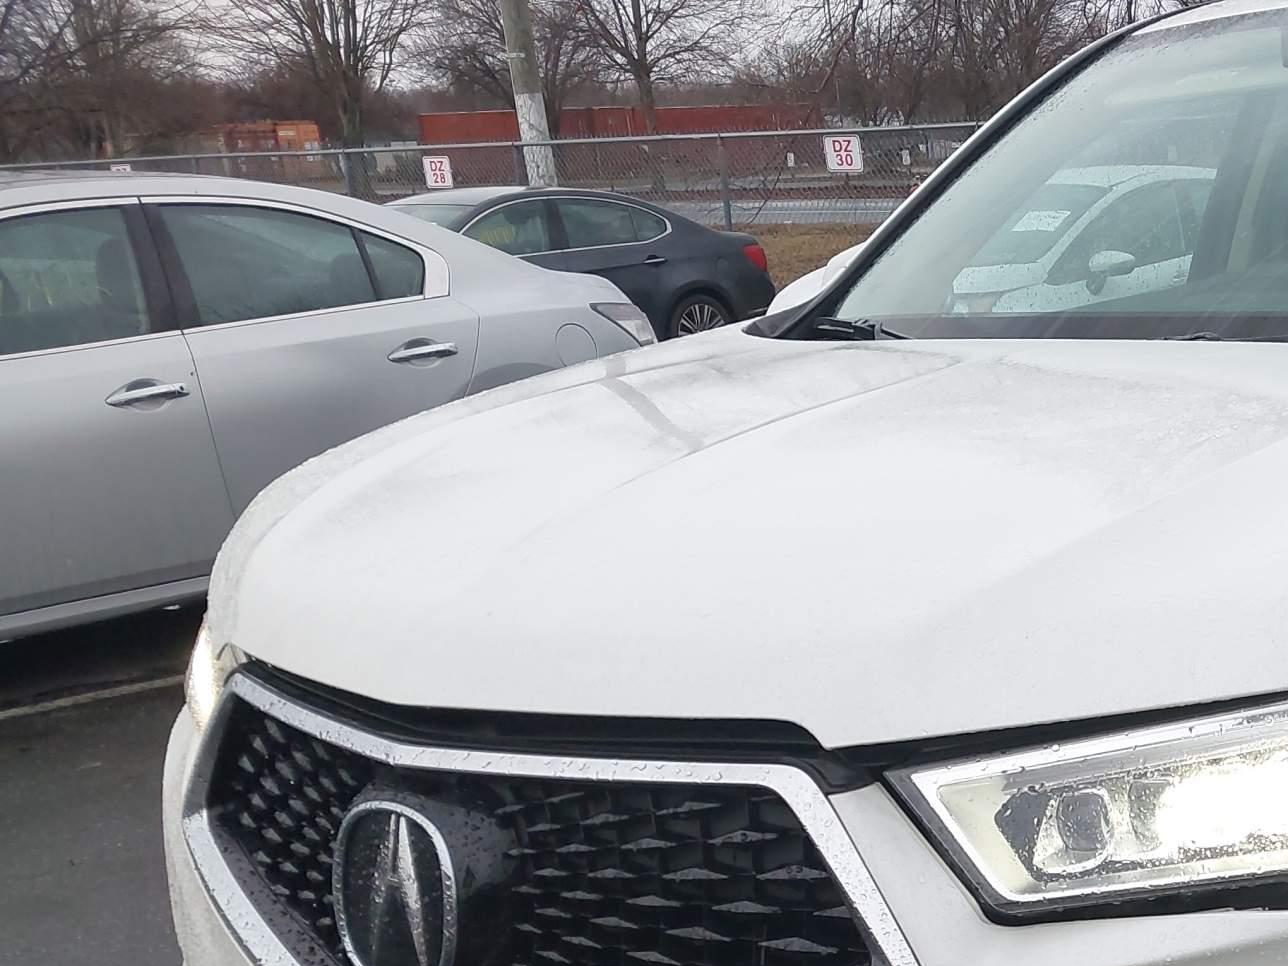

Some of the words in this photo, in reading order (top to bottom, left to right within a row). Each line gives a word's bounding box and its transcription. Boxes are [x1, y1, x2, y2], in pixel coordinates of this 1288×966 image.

[832, 140, 853, 152] DZ
[835, 154, 854, 167] 30
[429, 161, 445, 172] DZ
[433, 173, 446, 184] 28
